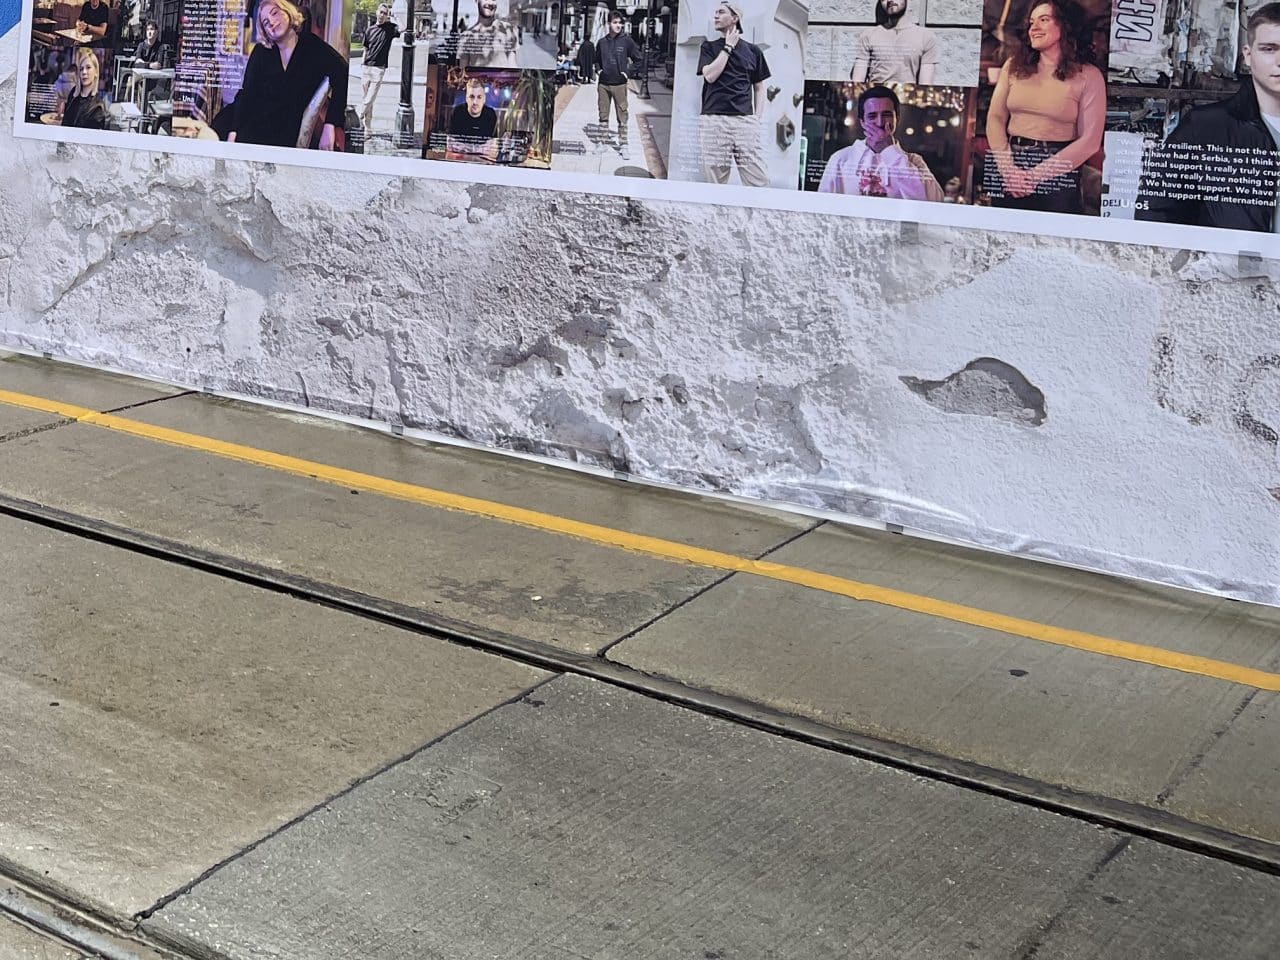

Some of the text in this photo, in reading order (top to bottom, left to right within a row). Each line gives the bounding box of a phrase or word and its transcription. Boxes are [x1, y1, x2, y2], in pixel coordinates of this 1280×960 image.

[1168, 143, 1204, 151] resilient.
[1206, 144, 1224, 153] This
[1235, 147, 1250, 155] not
[1252, 147, 1267, 156] the
[1151, 151, 1171, 159] have
[1173, 152, 1189, 160] had
[1201, 154, 1231, 164] Serbia,
[1251, 157, 1274, 166] think
[1169, 161, 1203, 172] support
[1205, 164, 1212, 172] is
[1214, 165, 1238, 175] really
[1239, 167, 1260, 177] truly
[1180, 172, 1204, 182] really
[1205, 173, 1226, 183] have
[1228, 176, 1262, 187] nothing
[1145, 179, 1160, 187] We
[1161, 180, 1182, 189] have
[1197, 184, 1233, 194] support.
[1235, 186, 1250, 195] We
[1252, 187, 1274, 197] have
[1167, 191, 1277, 207] support and international
